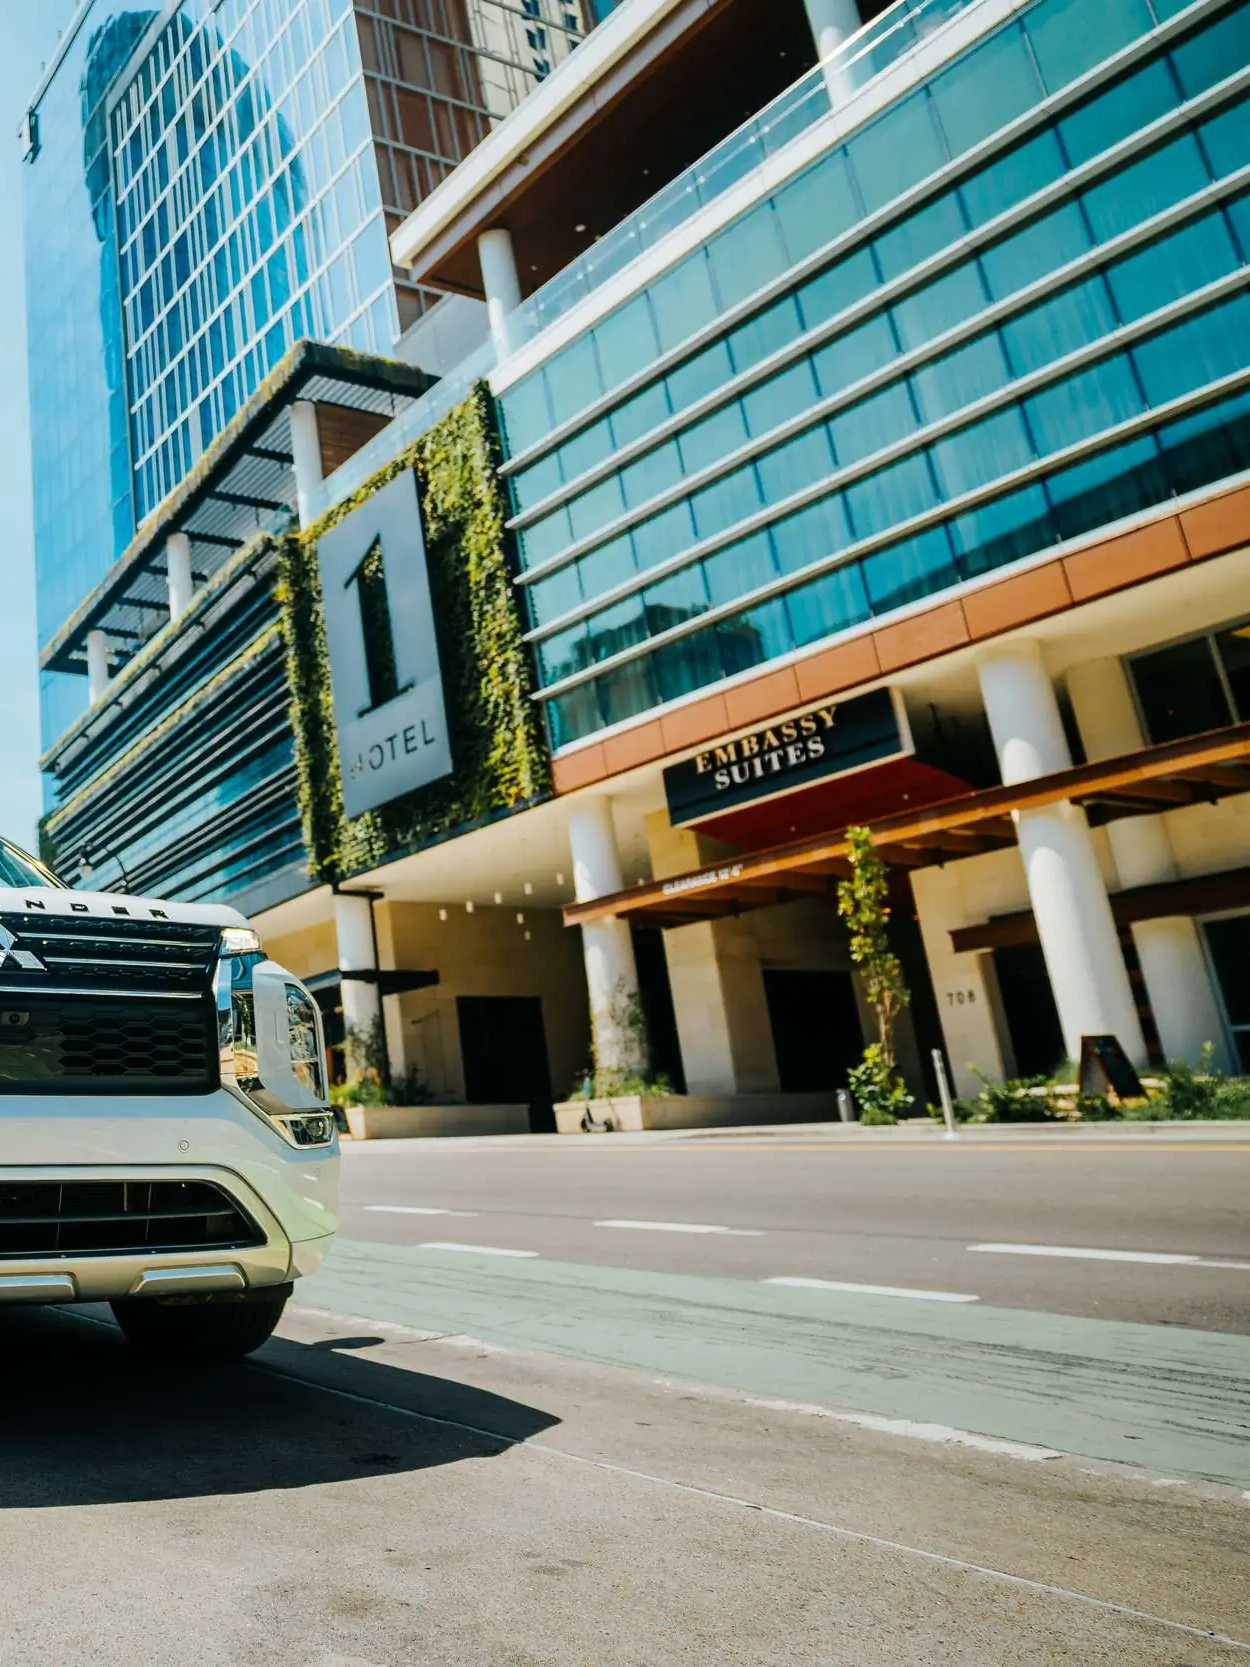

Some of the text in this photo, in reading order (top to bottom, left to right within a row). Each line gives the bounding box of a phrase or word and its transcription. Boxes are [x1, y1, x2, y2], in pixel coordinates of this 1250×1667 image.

[344, 531, 415, 718] 1
[694, 705, 838, 775] EMBASSY
[714, 736, 825, 790] SUITES
